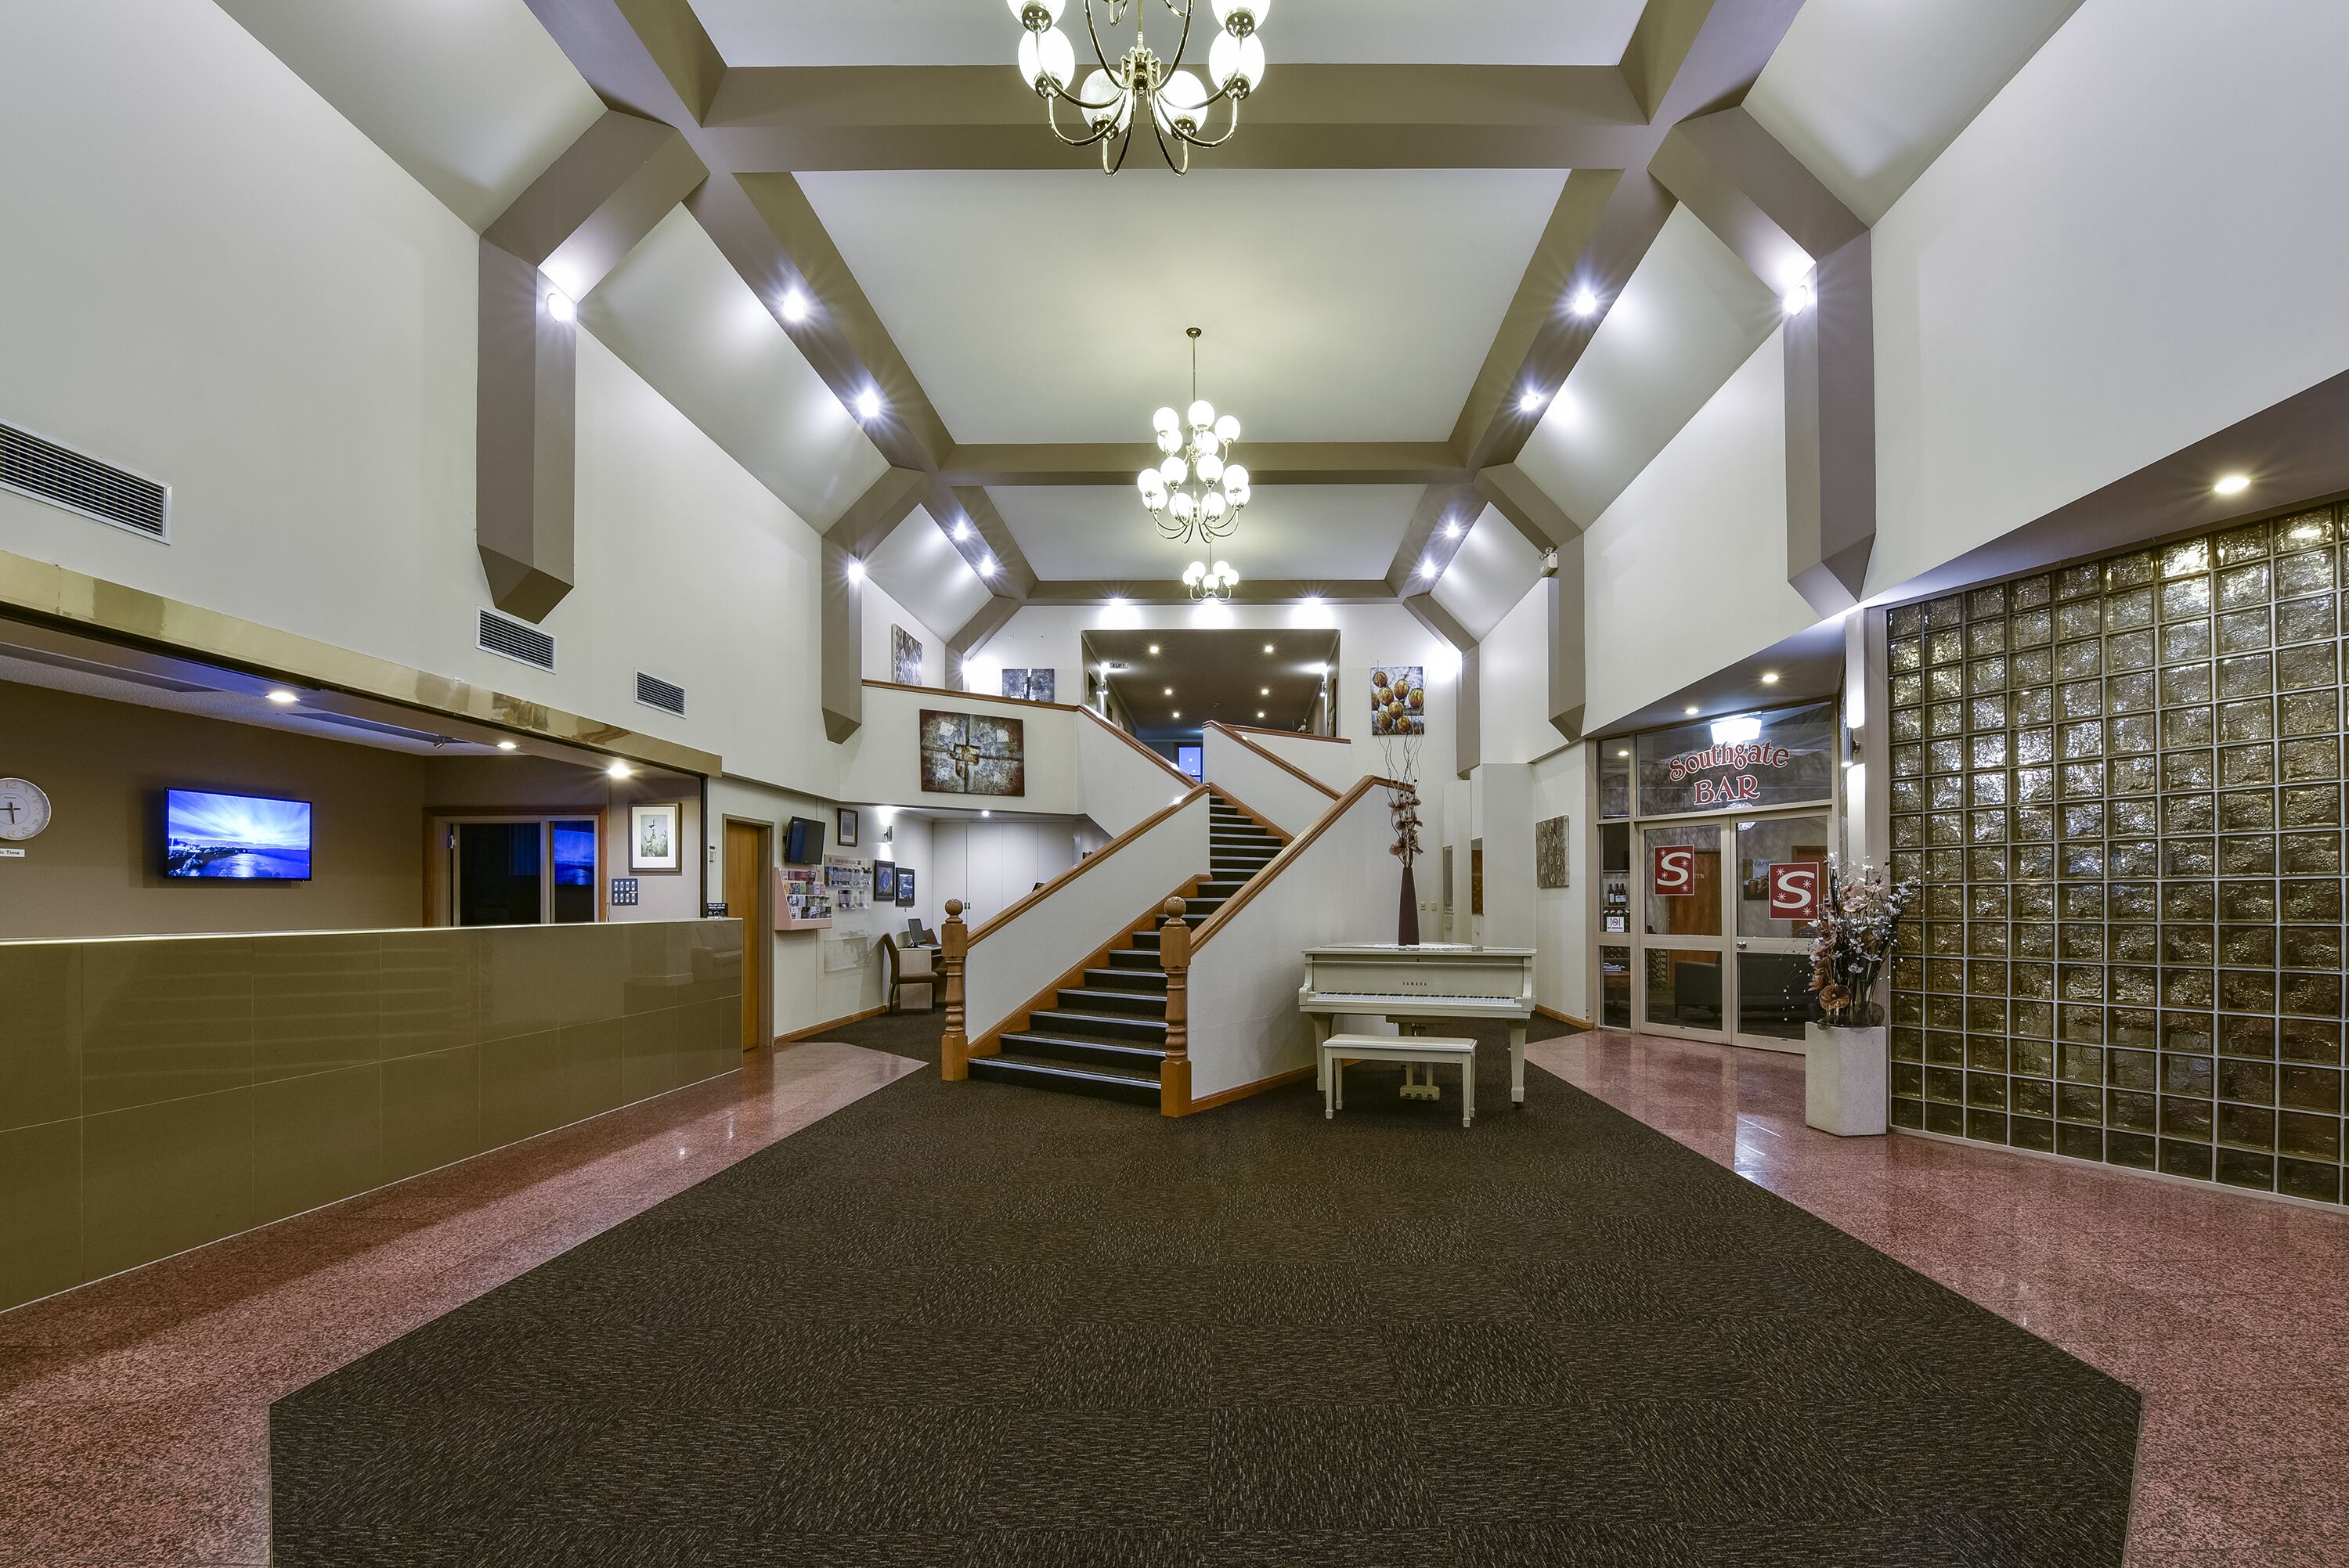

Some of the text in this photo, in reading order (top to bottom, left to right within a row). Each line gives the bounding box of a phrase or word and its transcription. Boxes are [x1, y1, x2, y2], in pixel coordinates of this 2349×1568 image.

[1669, 740, 1791, 781] Southgate
[1694, 774, 1761, 806] BAR
[1657, 852, 1691, 886] S
[1772, 871, 1815, 909] S
